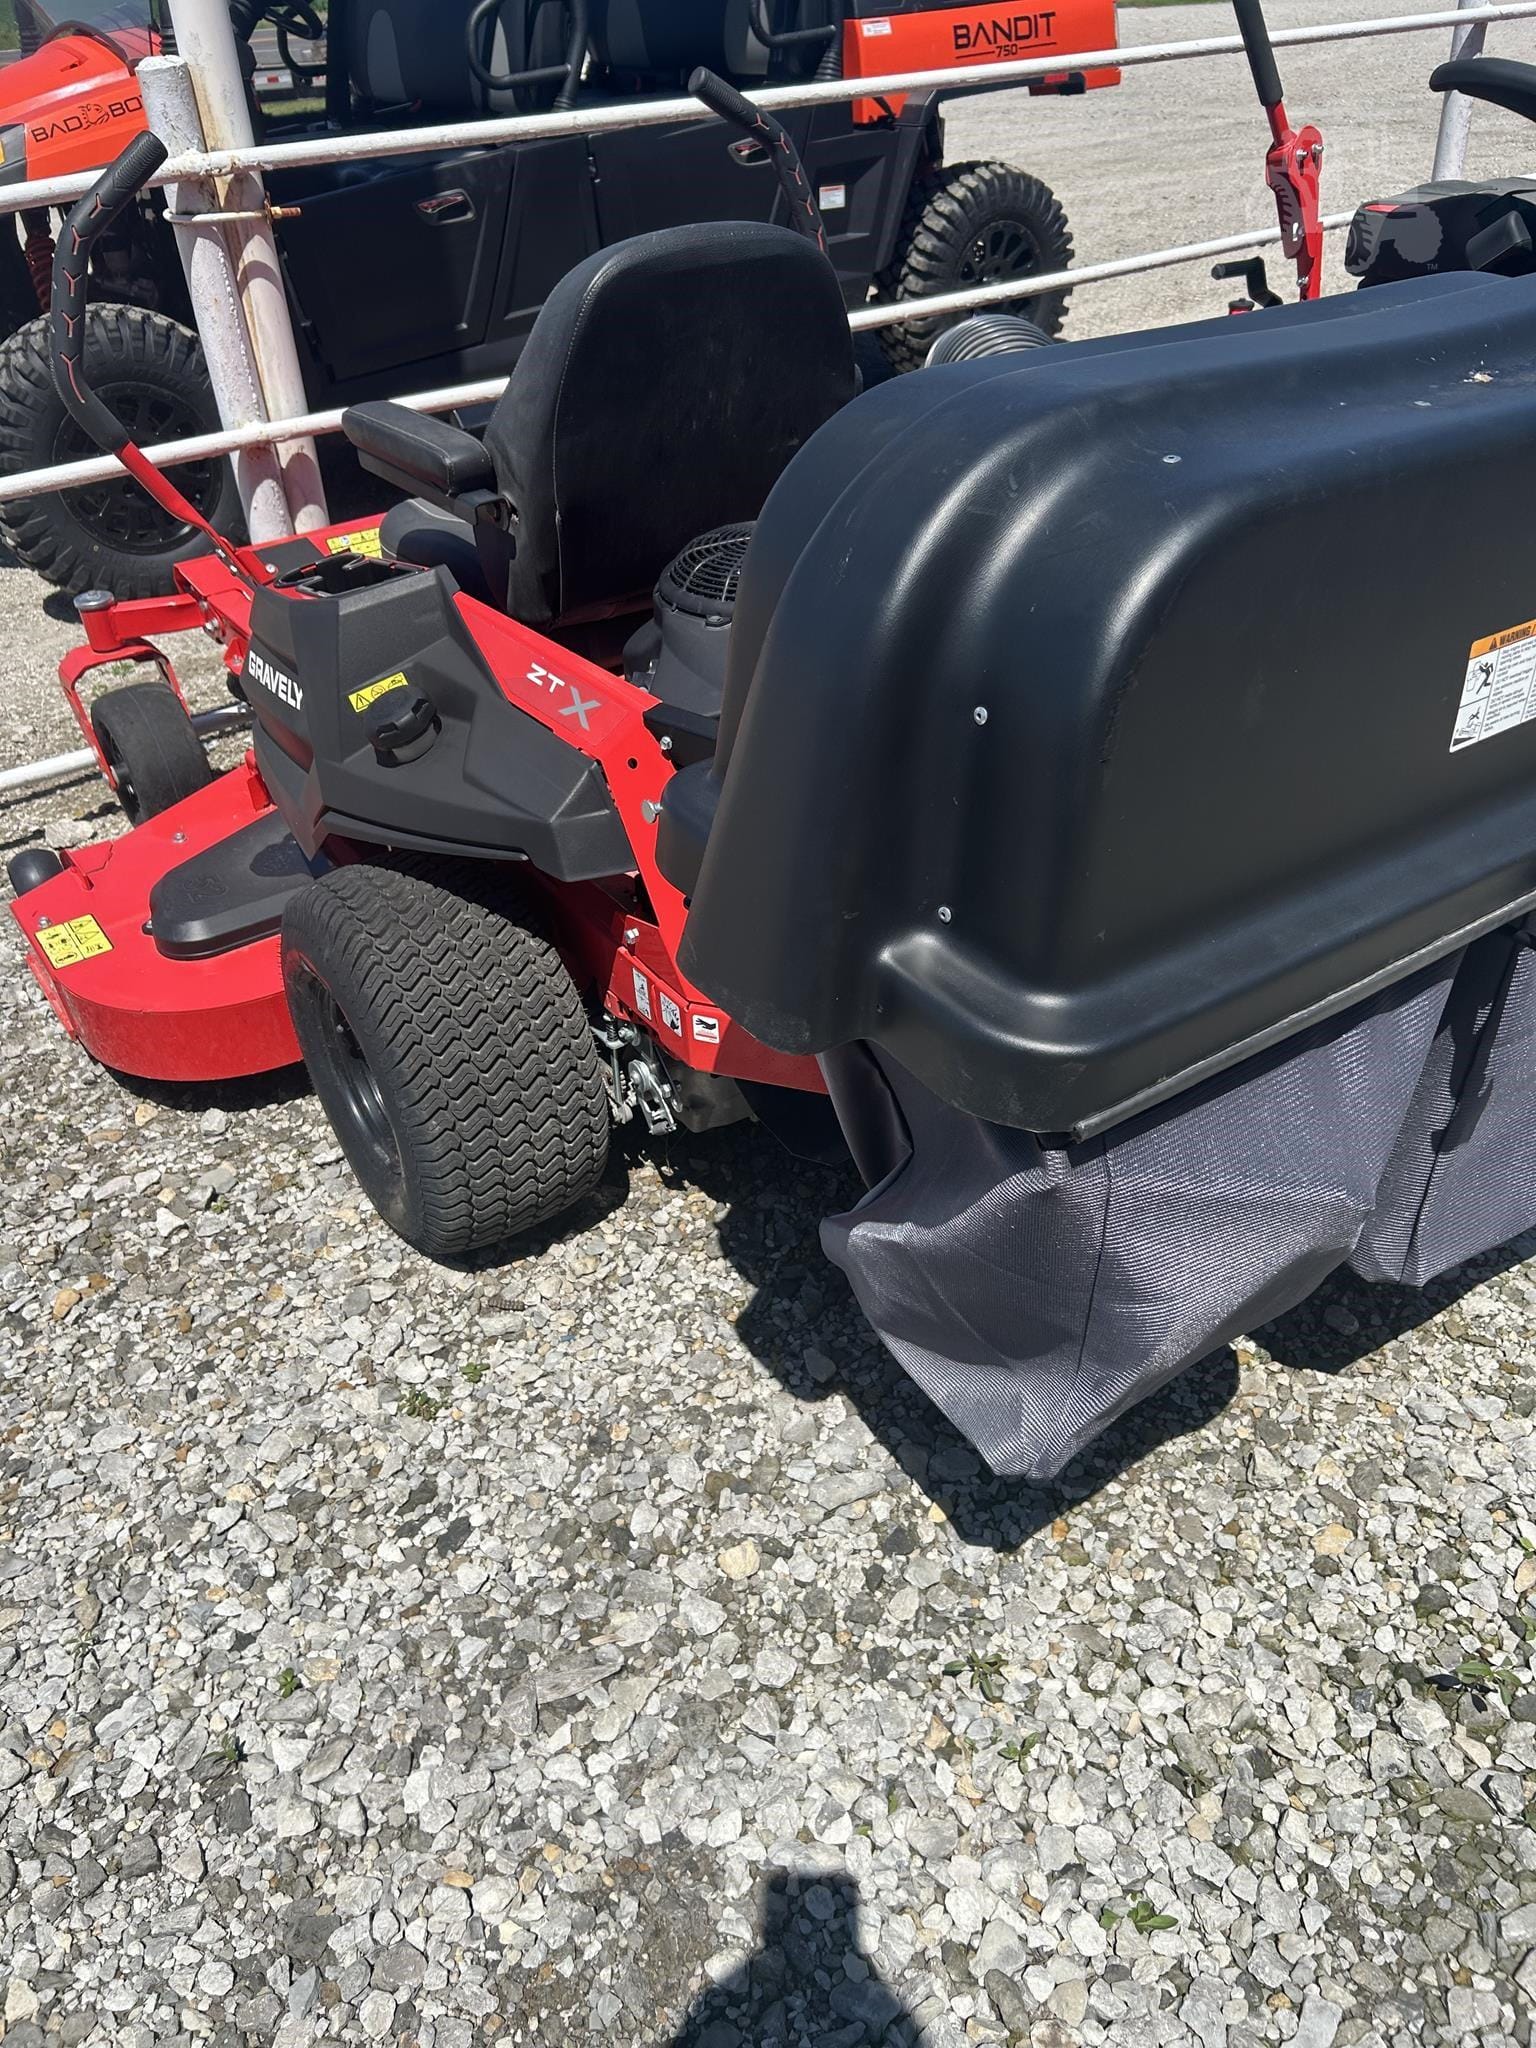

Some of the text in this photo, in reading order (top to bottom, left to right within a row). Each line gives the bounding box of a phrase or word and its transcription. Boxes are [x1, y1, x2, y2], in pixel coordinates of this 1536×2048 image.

[953, 12, 1056, 50] BANDIT
[995, 44, 1019, 57] 750
[31, 95, 143, 142] BAD BO
[1499, 625, 1532, 644] WARNING
[249, 650, 303, 711] GRAVELY
